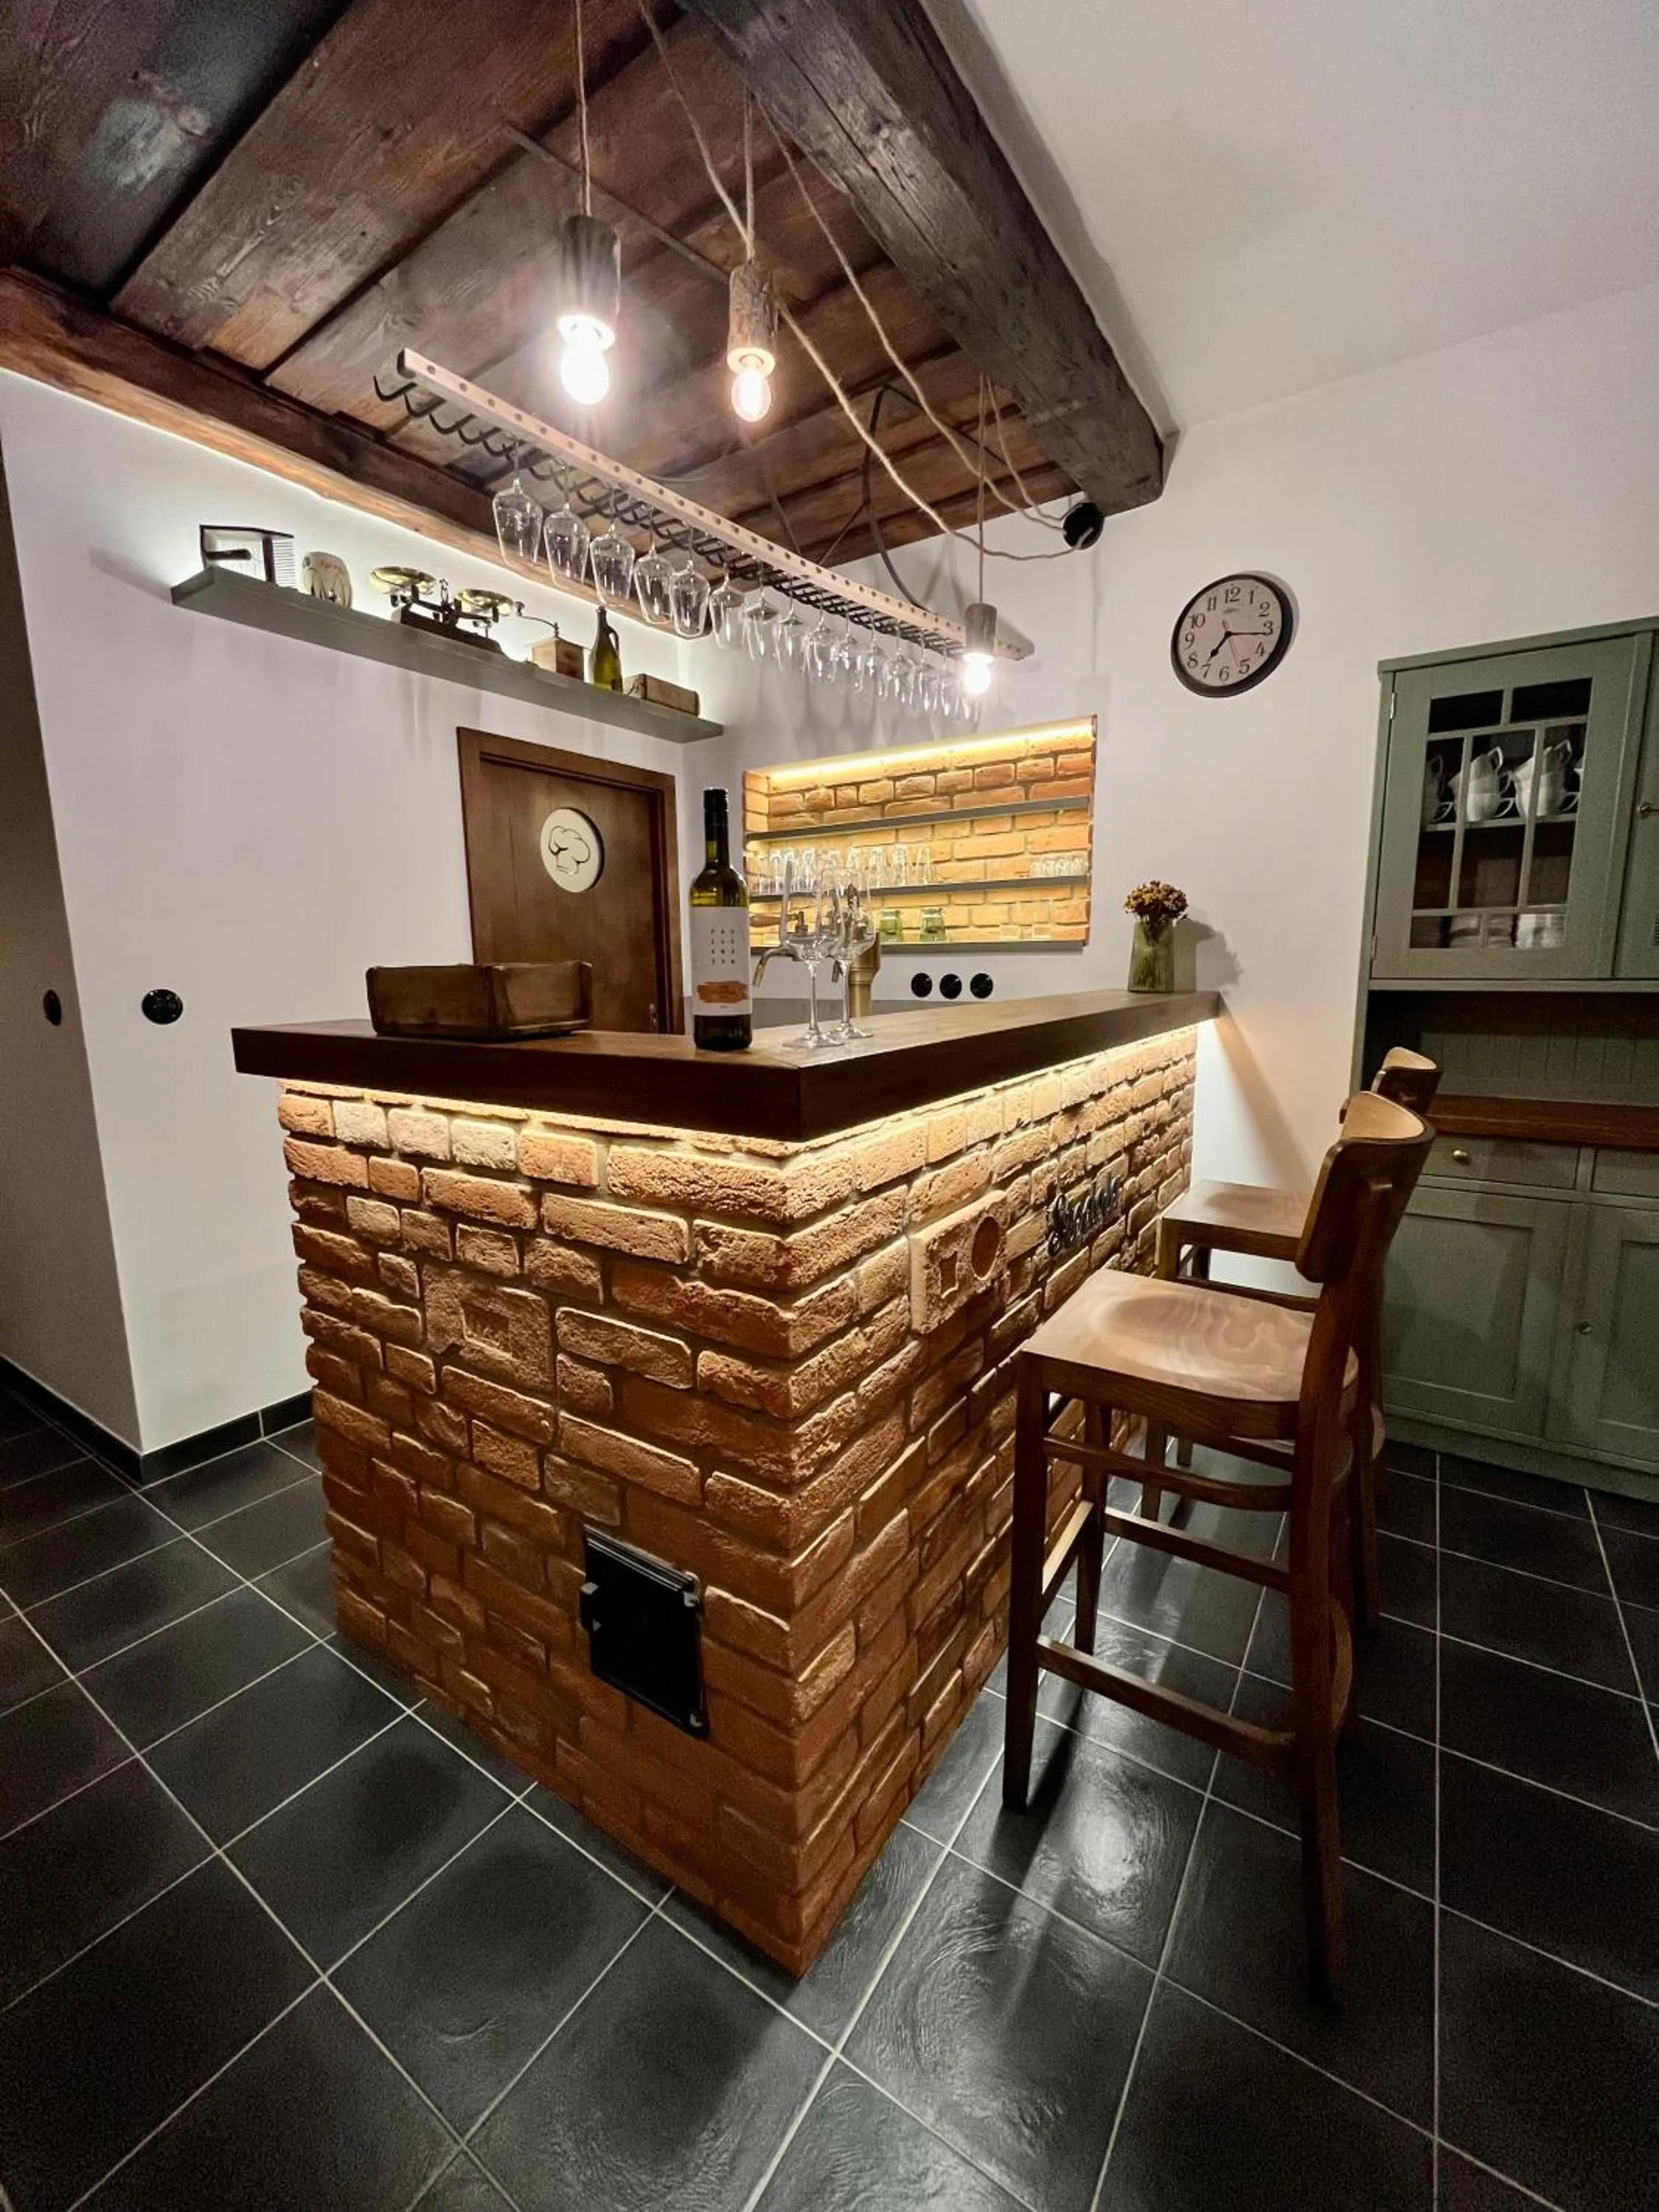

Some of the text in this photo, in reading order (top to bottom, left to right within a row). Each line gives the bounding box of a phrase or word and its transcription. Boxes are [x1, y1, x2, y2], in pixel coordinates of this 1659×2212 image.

[1224, 586, 1241, 603] 12
[1248, 590, 1254, 604] 1
[1207, 596, 1217, 612] 11
[1259, 602, 1270, 617] 2
[1189, 613, 1206, 629] 10
[1262, 621, 1274, 636] 3
[1185, 632, 1195, 649] 9
[1255, 641, 1266, 656] 4
[1187, 652, 1198, 669] 8
[1238, 658, 1250, 674] 5
[1202, 664, 1211, 678] 7
[1219, 666, 1230, 682] 6
